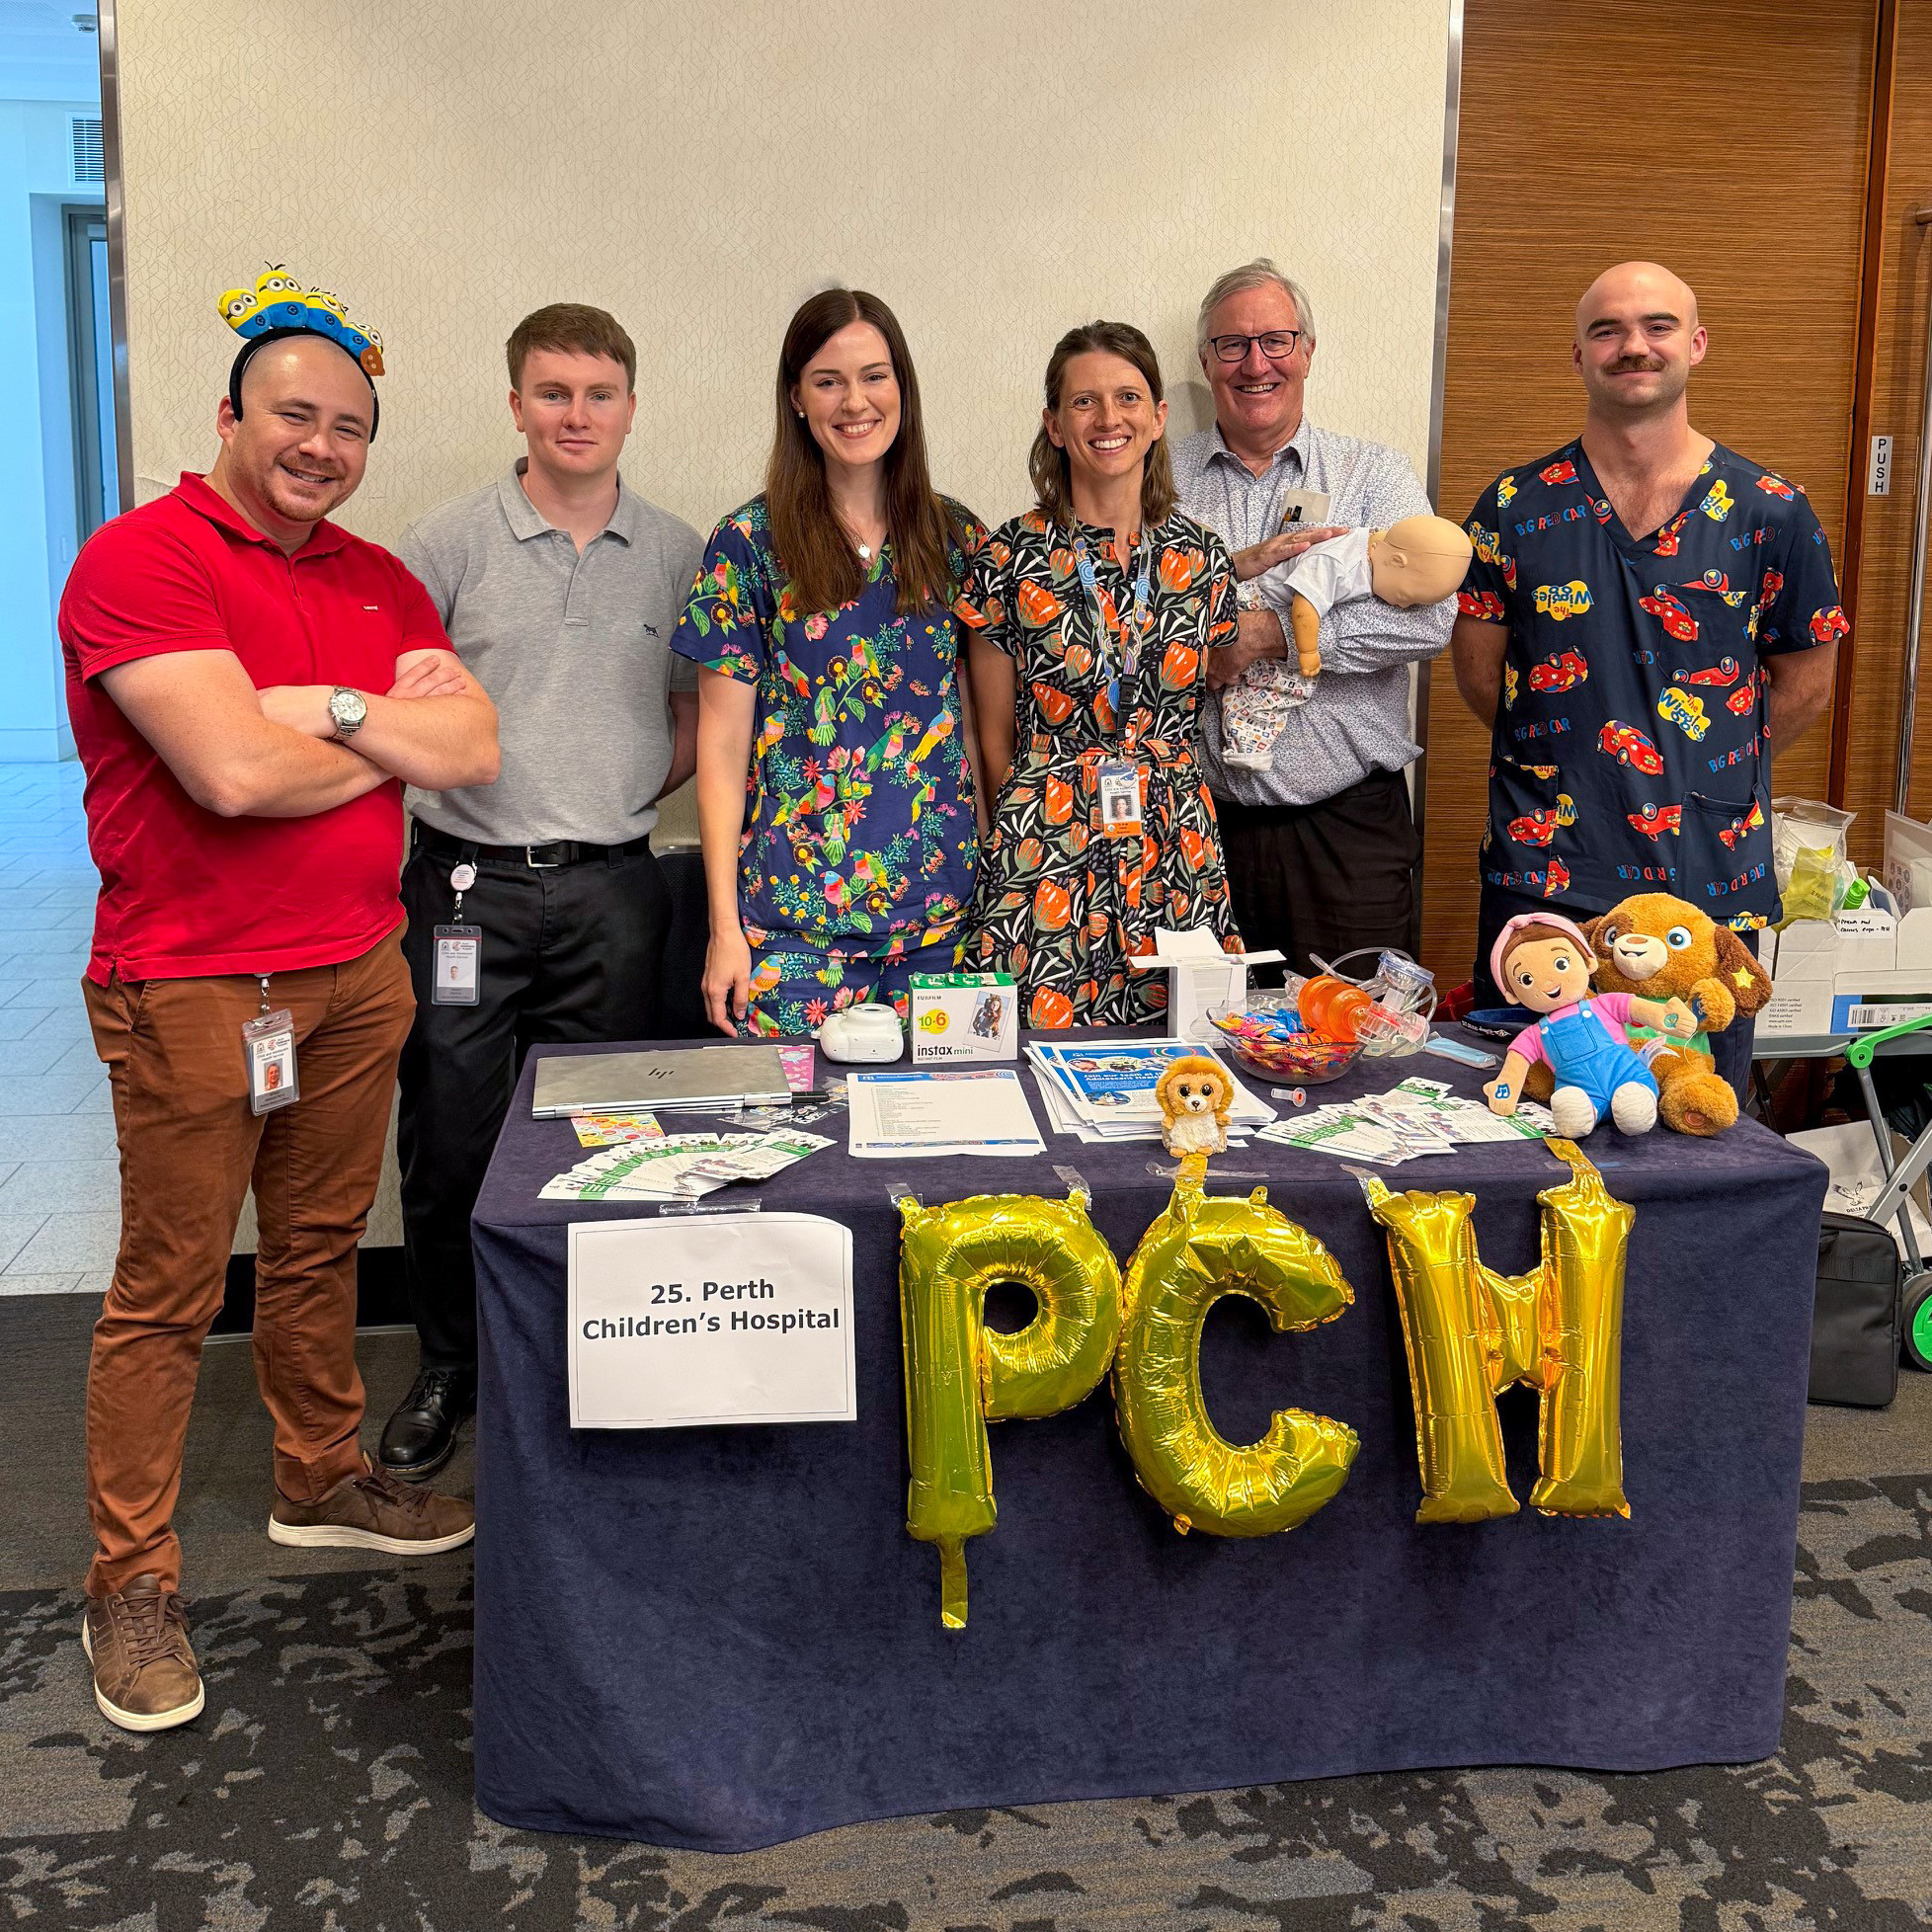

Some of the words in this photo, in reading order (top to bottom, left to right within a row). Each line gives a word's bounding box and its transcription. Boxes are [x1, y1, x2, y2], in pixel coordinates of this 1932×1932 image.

[1875, 439, 1887, 493] PUSH
[1514, 520, 1535, 537] BIG
[1537, 512, 1561, 530] RED
[1563, 505, 1586, 522] CAR
[1730, 532, 1750, 551] BIG
[1753, 525, 1776, 544] RED
[1533, 586, 1594, 609] Wiggles
[1554, 606, 1572, 618] The
[1686, 692, 1699, 713] The
[1659, 687, 1707, 742] Wiggles
[1528, 721, 1548, 739] RED
[1549, 717, 1571, 734] CAR
[1708, 755, 1726, 773] BIG
[1523, 870, 1547, 885] CAR
[1616, 864, 1641, 880] CAR
[1750, 862, 1765, 883] BIG
[1706, 881, 1729, 897] CAR
[918, 1045, 952, 1057] instax
[650, 1284, 691, 1305] 25.
[702, 1278, 774, 1301] Perth
[583, 1312, 721, 1340] Children’s
[731, 1308, 839, 1334] Hospital
